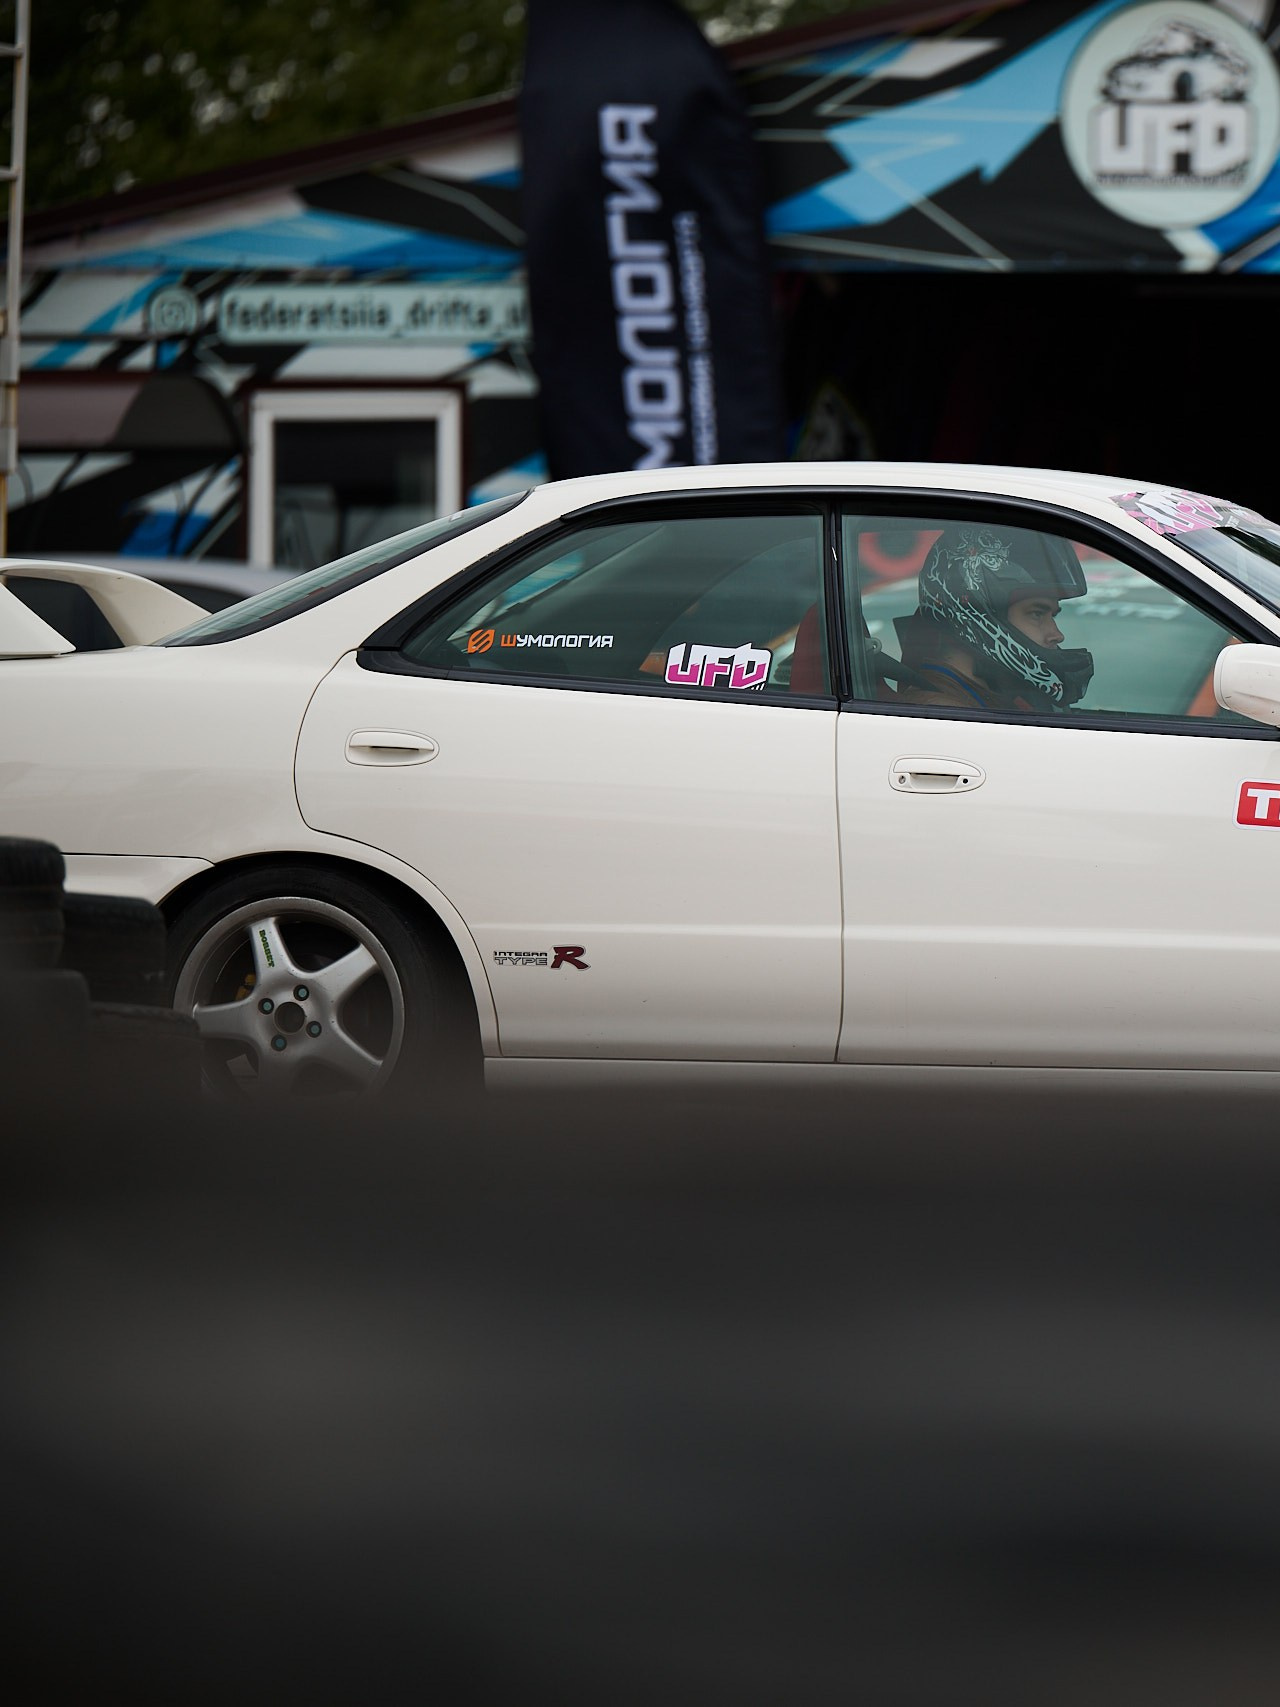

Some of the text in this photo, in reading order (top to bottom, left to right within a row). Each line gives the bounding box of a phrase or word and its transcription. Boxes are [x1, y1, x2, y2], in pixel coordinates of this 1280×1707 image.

[1096, 101, 1249, 175] UFD
[500, 633, 614, 648] ШУМОЛОГИЯ
[665, 642, 772, 690] UFD
[494, 946, 590, 970] TYPE R
